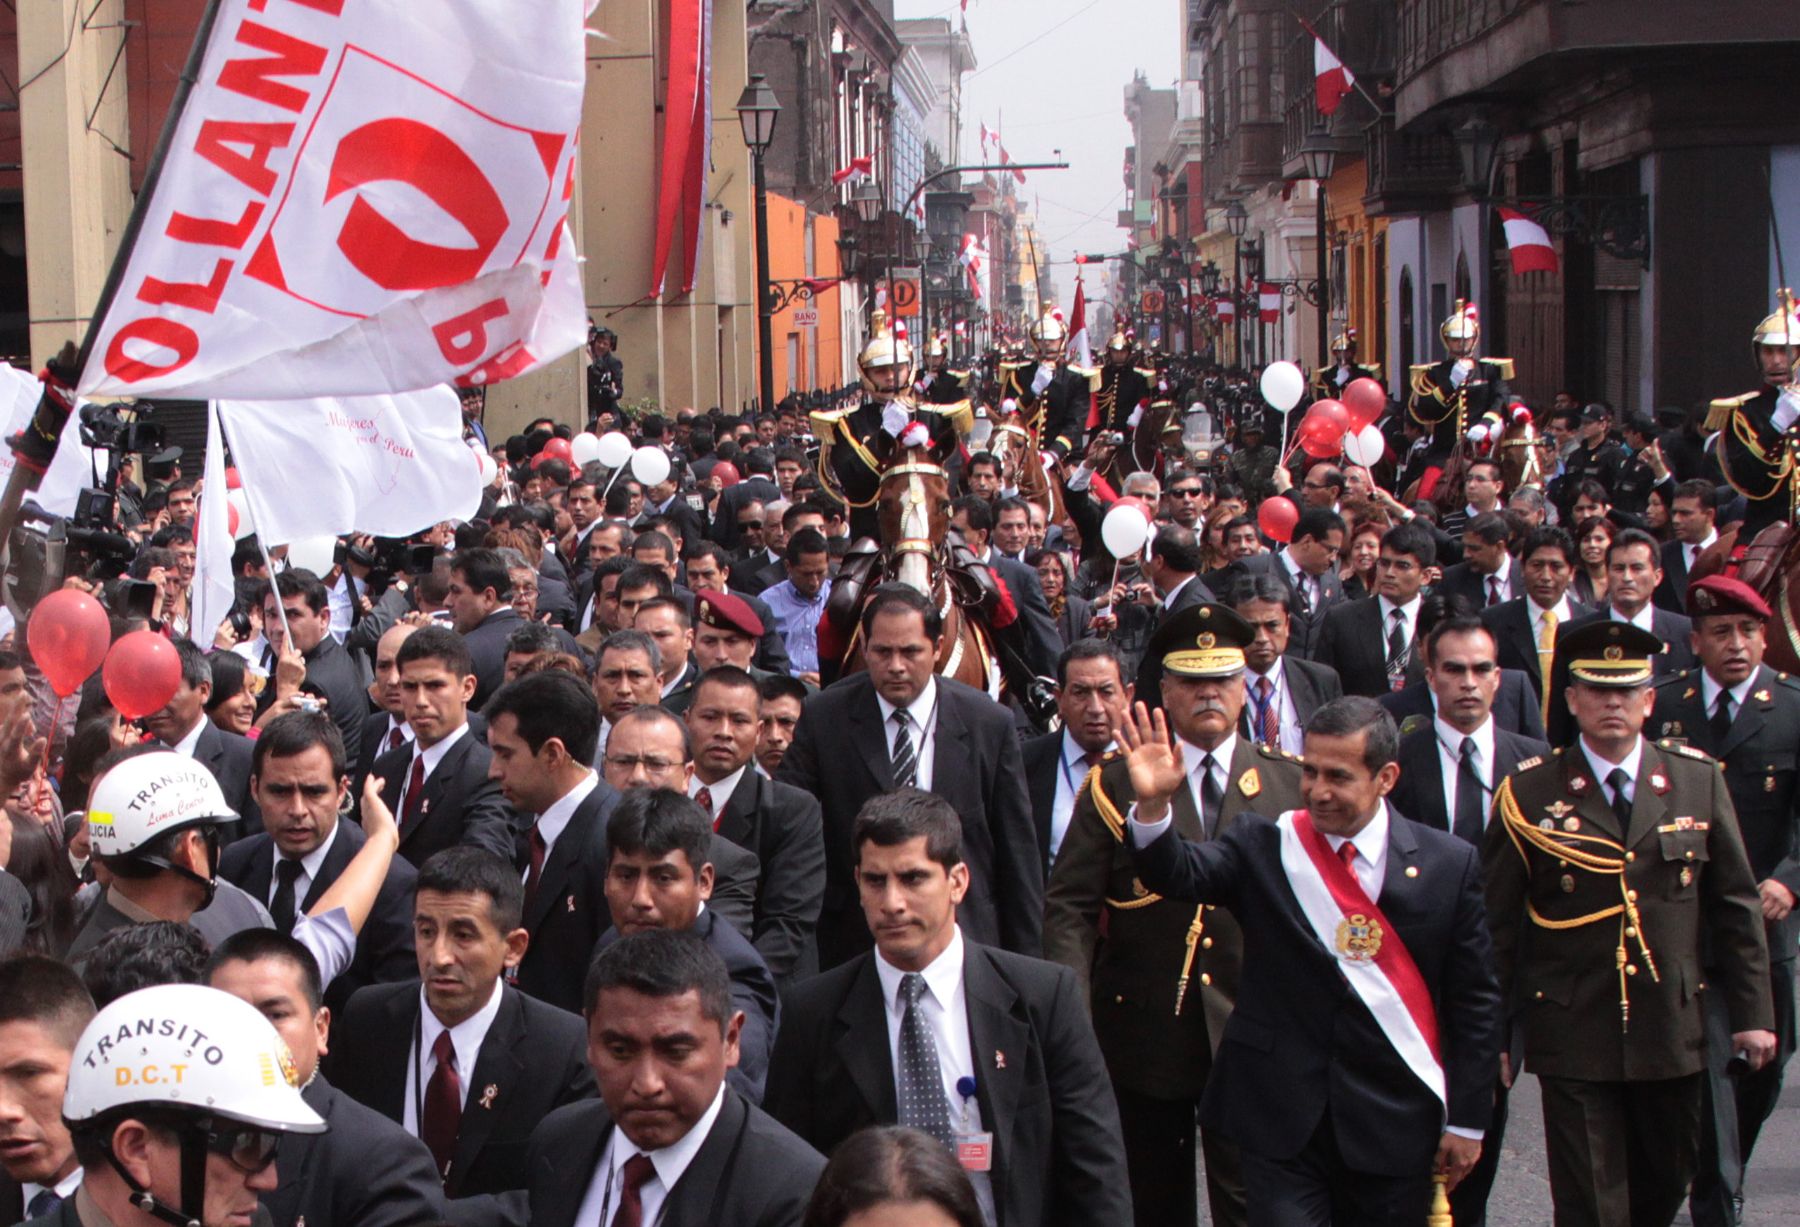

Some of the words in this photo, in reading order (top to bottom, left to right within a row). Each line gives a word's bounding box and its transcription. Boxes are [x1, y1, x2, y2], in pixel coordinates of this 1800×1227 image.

[325, 411, 374, 432] Mujeres
[128, 773, 208, 812] TRANSITO
[83, 1018, 223, 1070] TRANSITO
[115, 1064, 188, 1086] D.C.T
